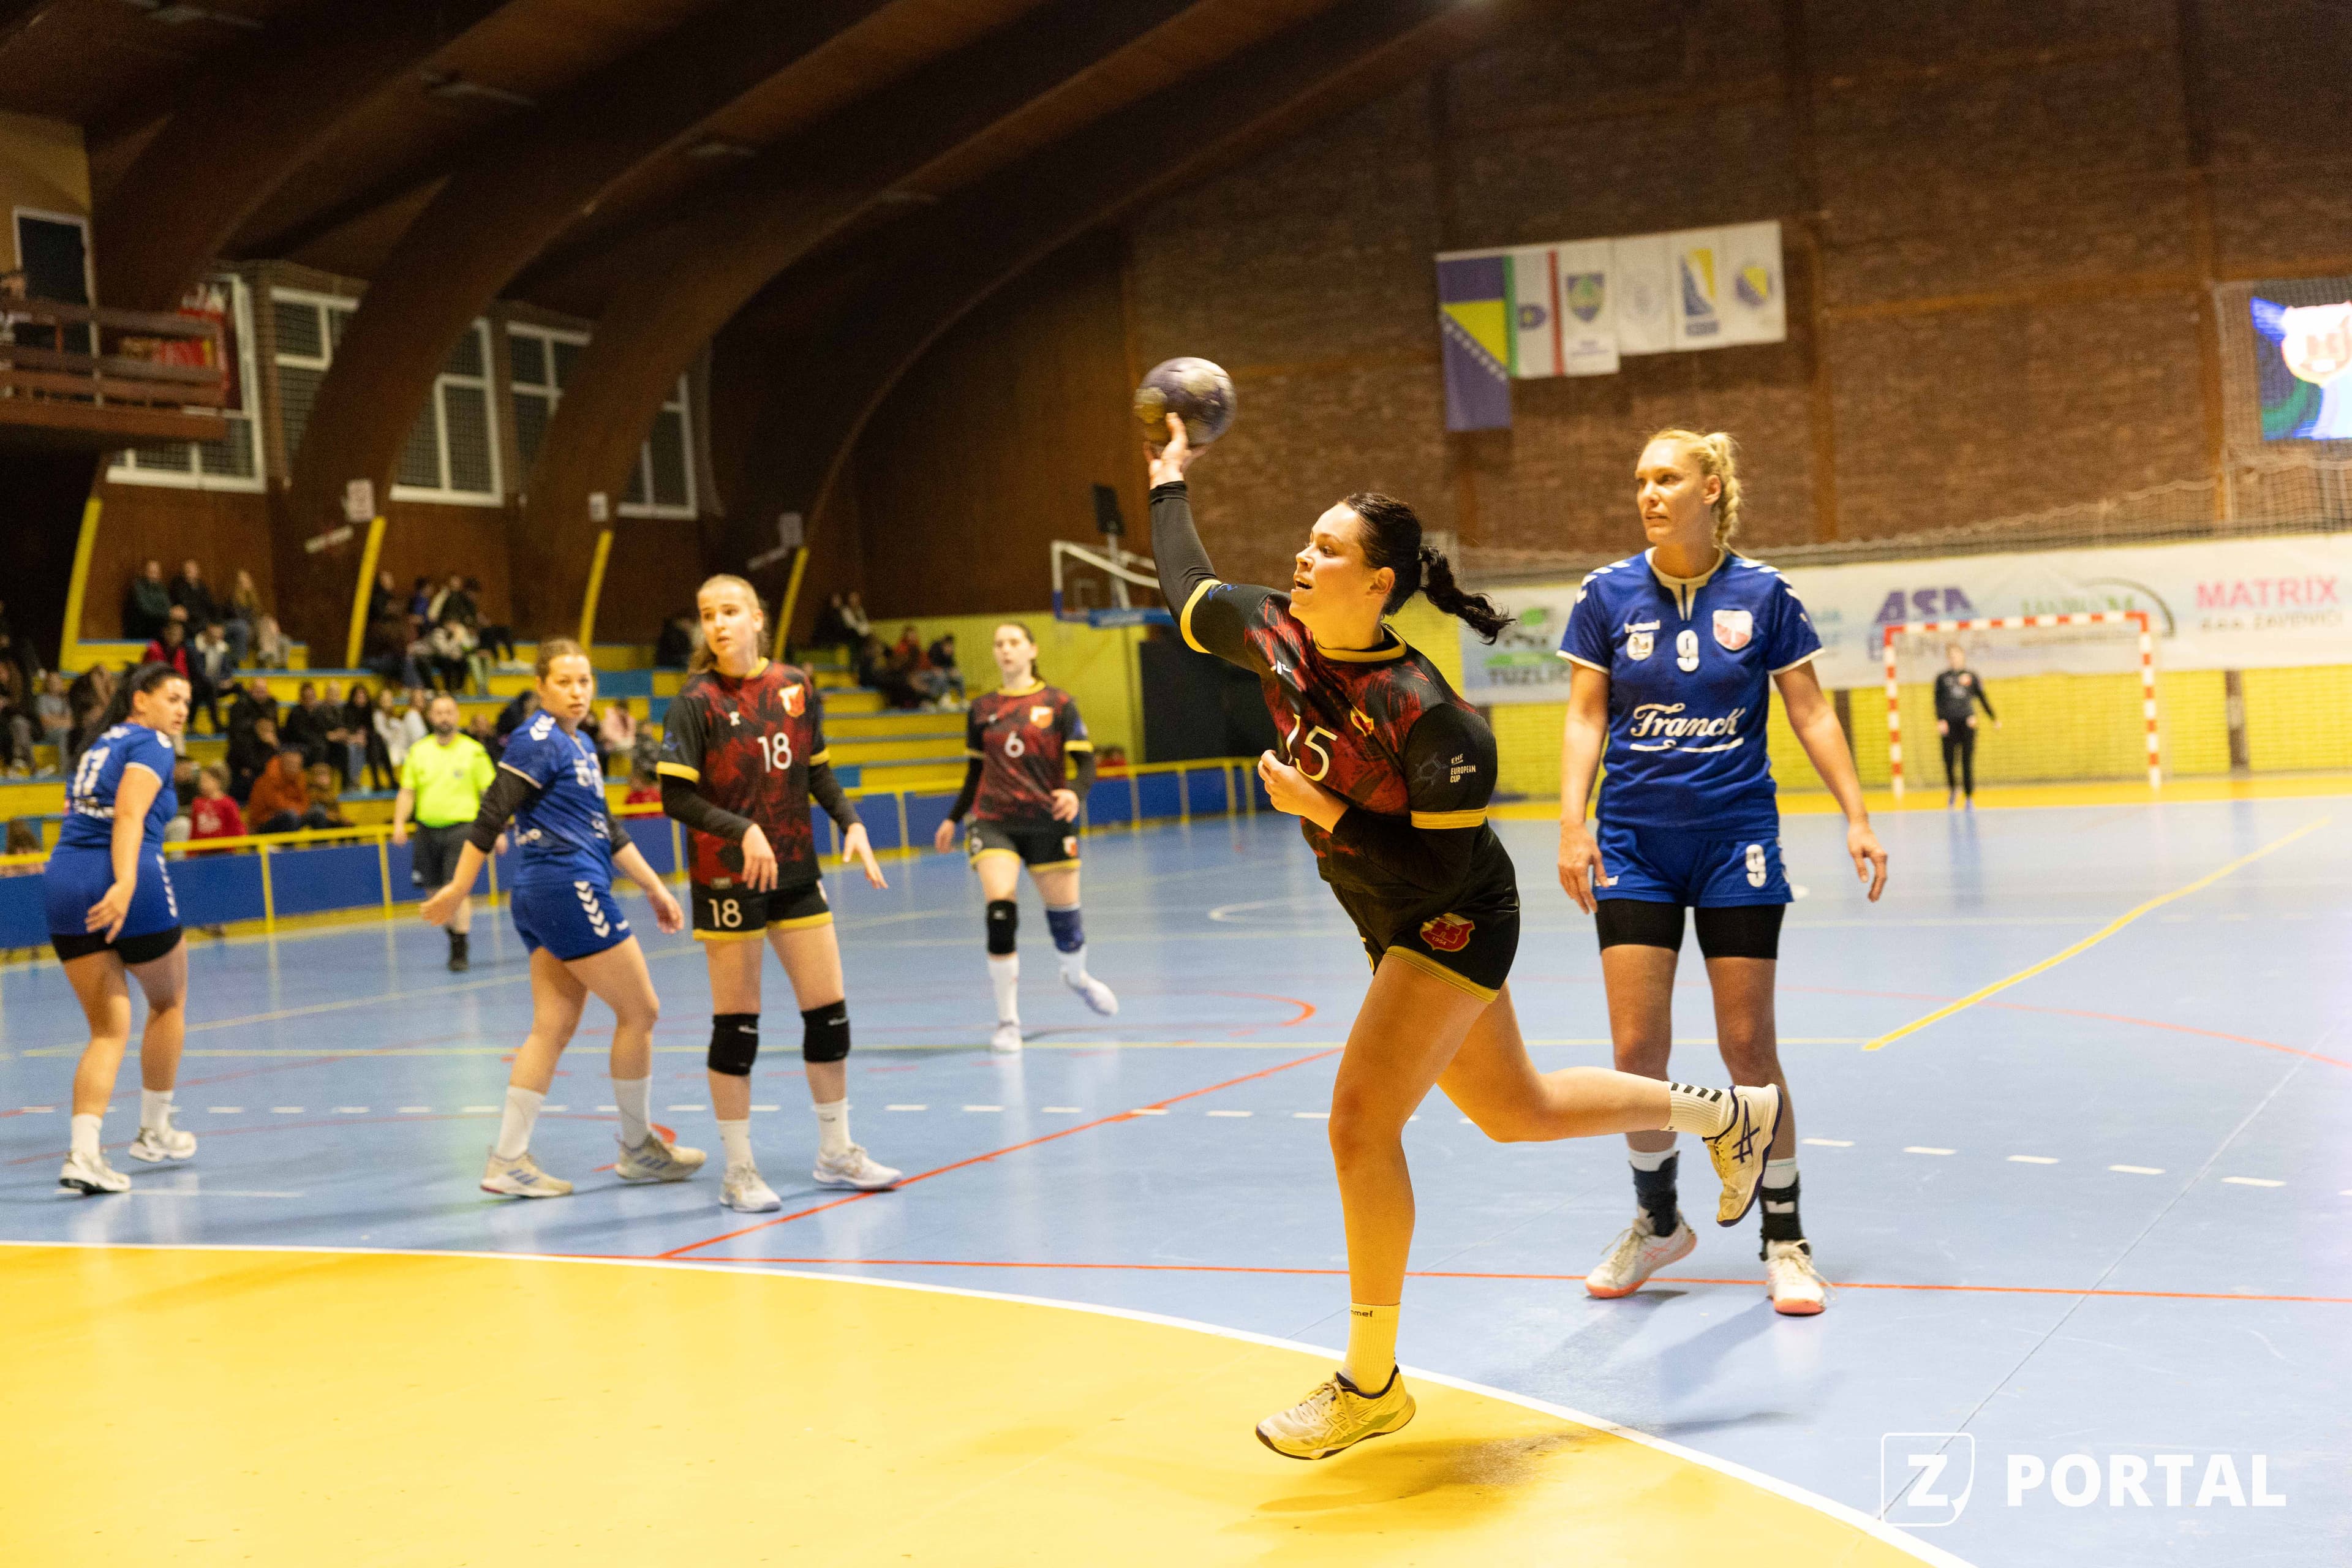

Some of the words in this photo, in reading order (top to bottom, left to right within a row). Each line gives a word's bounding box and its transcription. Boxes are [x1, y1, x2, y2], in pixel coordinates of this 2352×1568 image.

[2196, 575, 2339, 608] MATRIX
[1676, 630, 1700, 672] 9
[1630, 703, 1746, 737] Franck
[757, 732, 793, 773] 18
[1005, 731, 1025, 758] 6
[1286, 712, 1338, 782] 15
[1450, 753, 1464, 764] EHF
[1450, 764, 1476, 775] EUROPEAN
[1450, 775, 1461, 783] CUP
[1746, 844, 1766, 888] 9
[709, 899, 742, 928] 18
